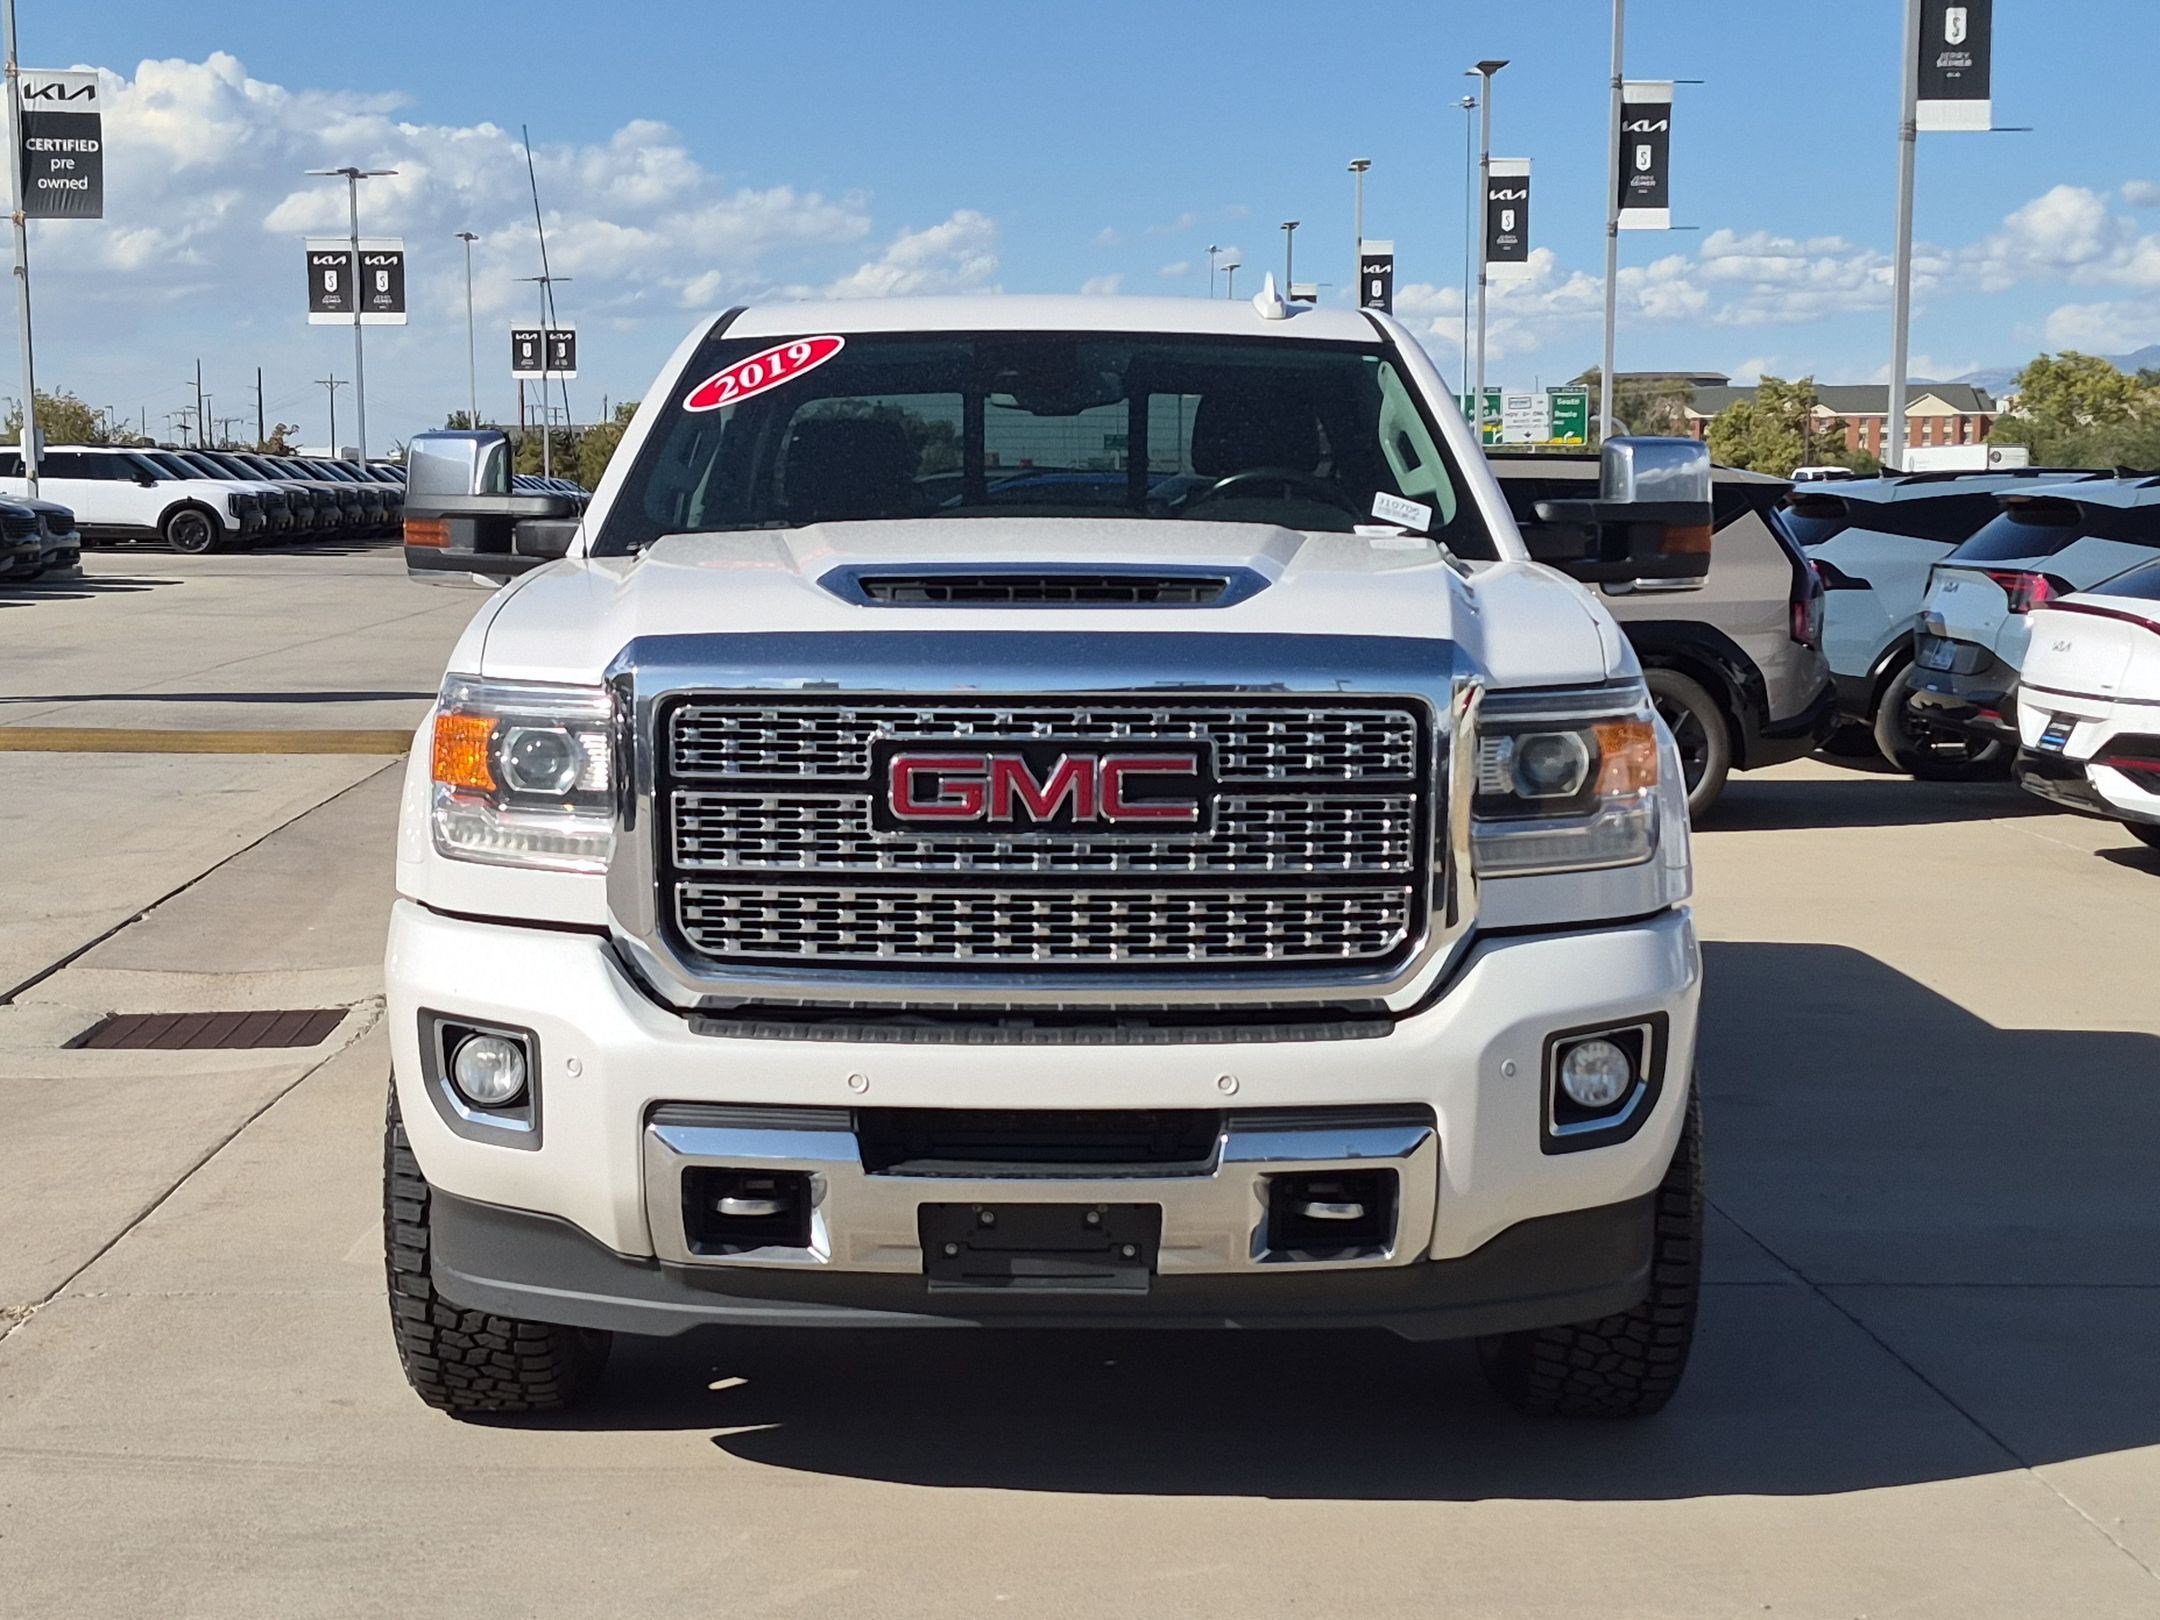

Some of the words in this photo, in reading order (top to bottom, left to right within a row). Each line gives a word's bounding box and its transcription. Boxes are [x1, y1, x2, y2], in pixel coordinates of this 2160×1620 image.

[23, 83, 96, 101] KIA
[1622, 119, 1668, 132] KIA
[25, 137, 100, 152] CERTIFIED
[50, 158, 76, 172] pre
[37, 175, 88, 190] owned
[1489, 189, 1527, 200] KIA
[312, 255, 347, 266] KIA
[364, 255, 399, 266] KIA
[1363, 264, 1392, 274] KIA
[714, 343, 812, 403] 2019
[889, 753, 1199, 823] GMC
